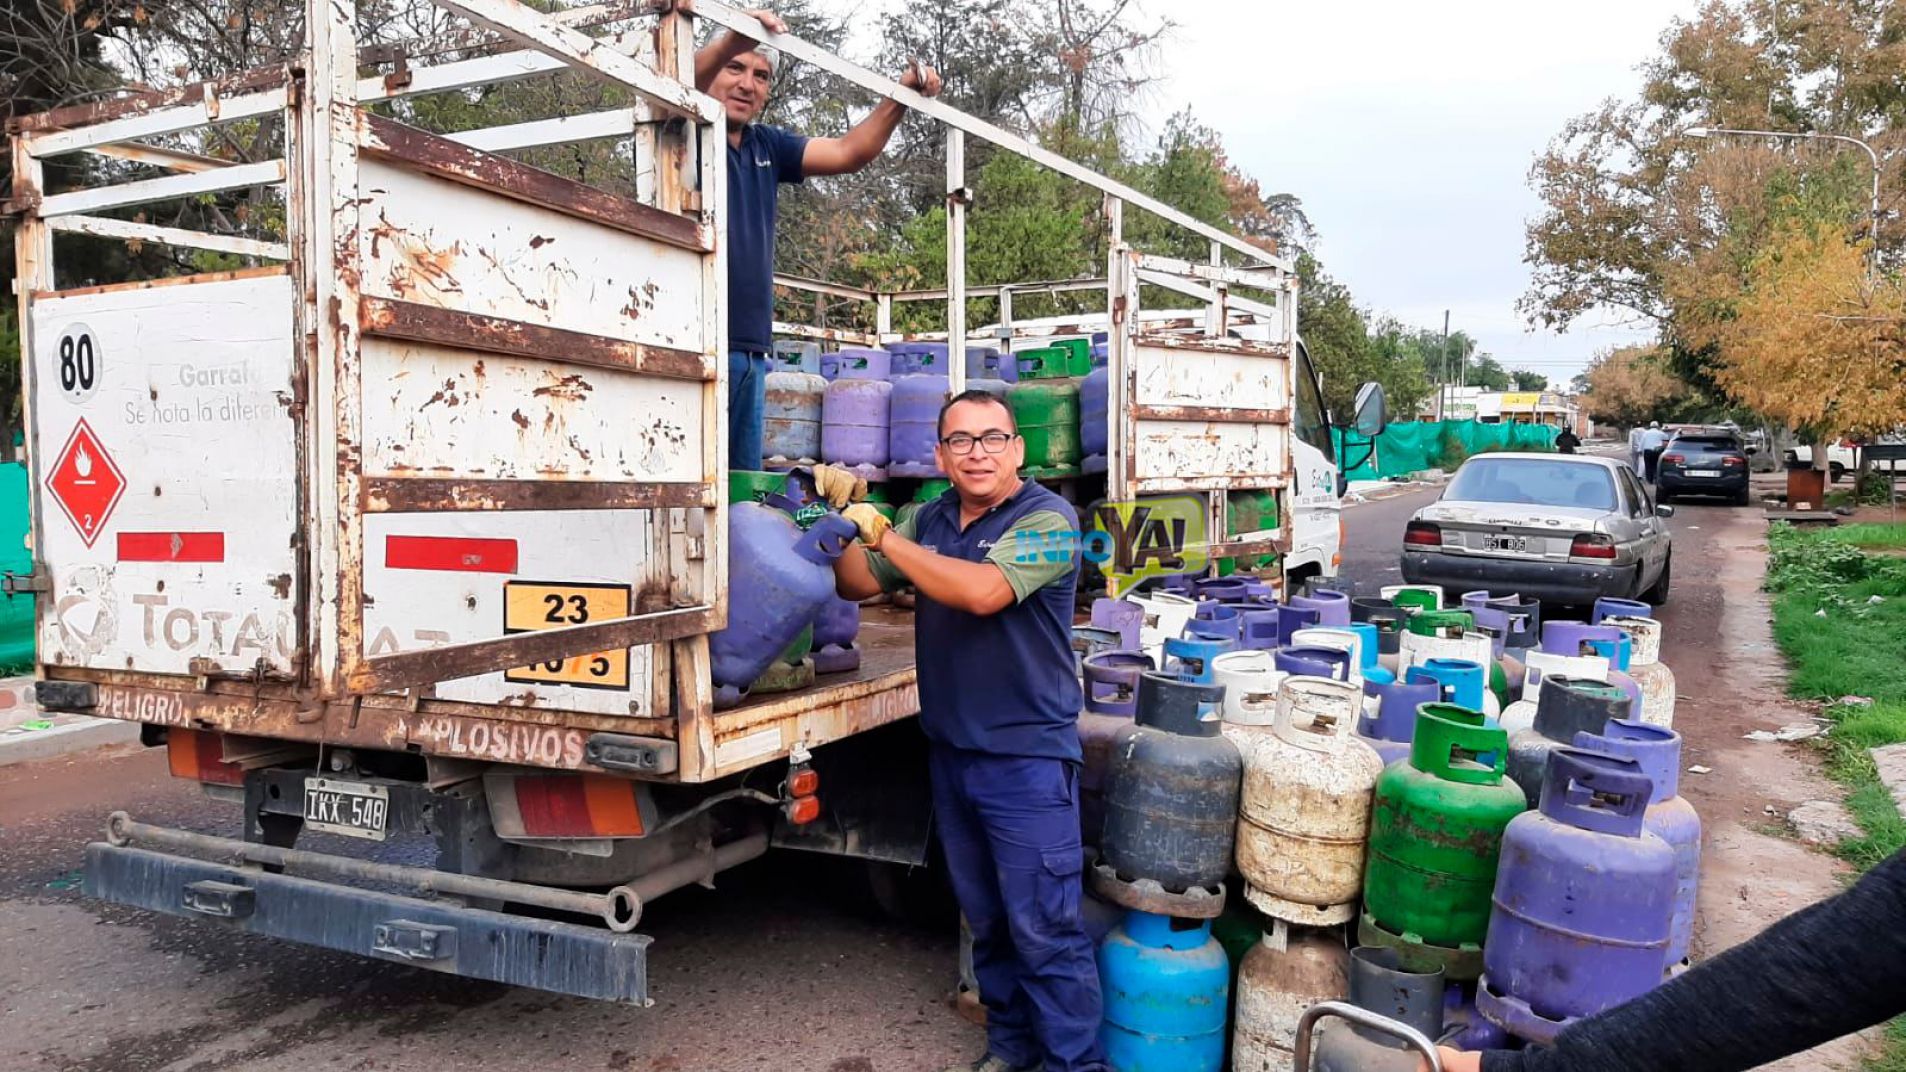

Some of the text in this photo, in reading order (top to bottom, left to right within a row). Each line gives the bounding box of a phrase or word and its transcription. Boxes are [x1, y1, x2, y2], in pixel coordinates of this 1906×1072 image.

[60, 334, 94, 391] 80
[126, 402, 146, 424] Se
[153, 402, 190, 424] nota
[197, 397, 213, 422] la
[84, 514, 93, 529] 2
[543, 594, 588, 624] 23
[307, 791, 384, 829] IKX 548
